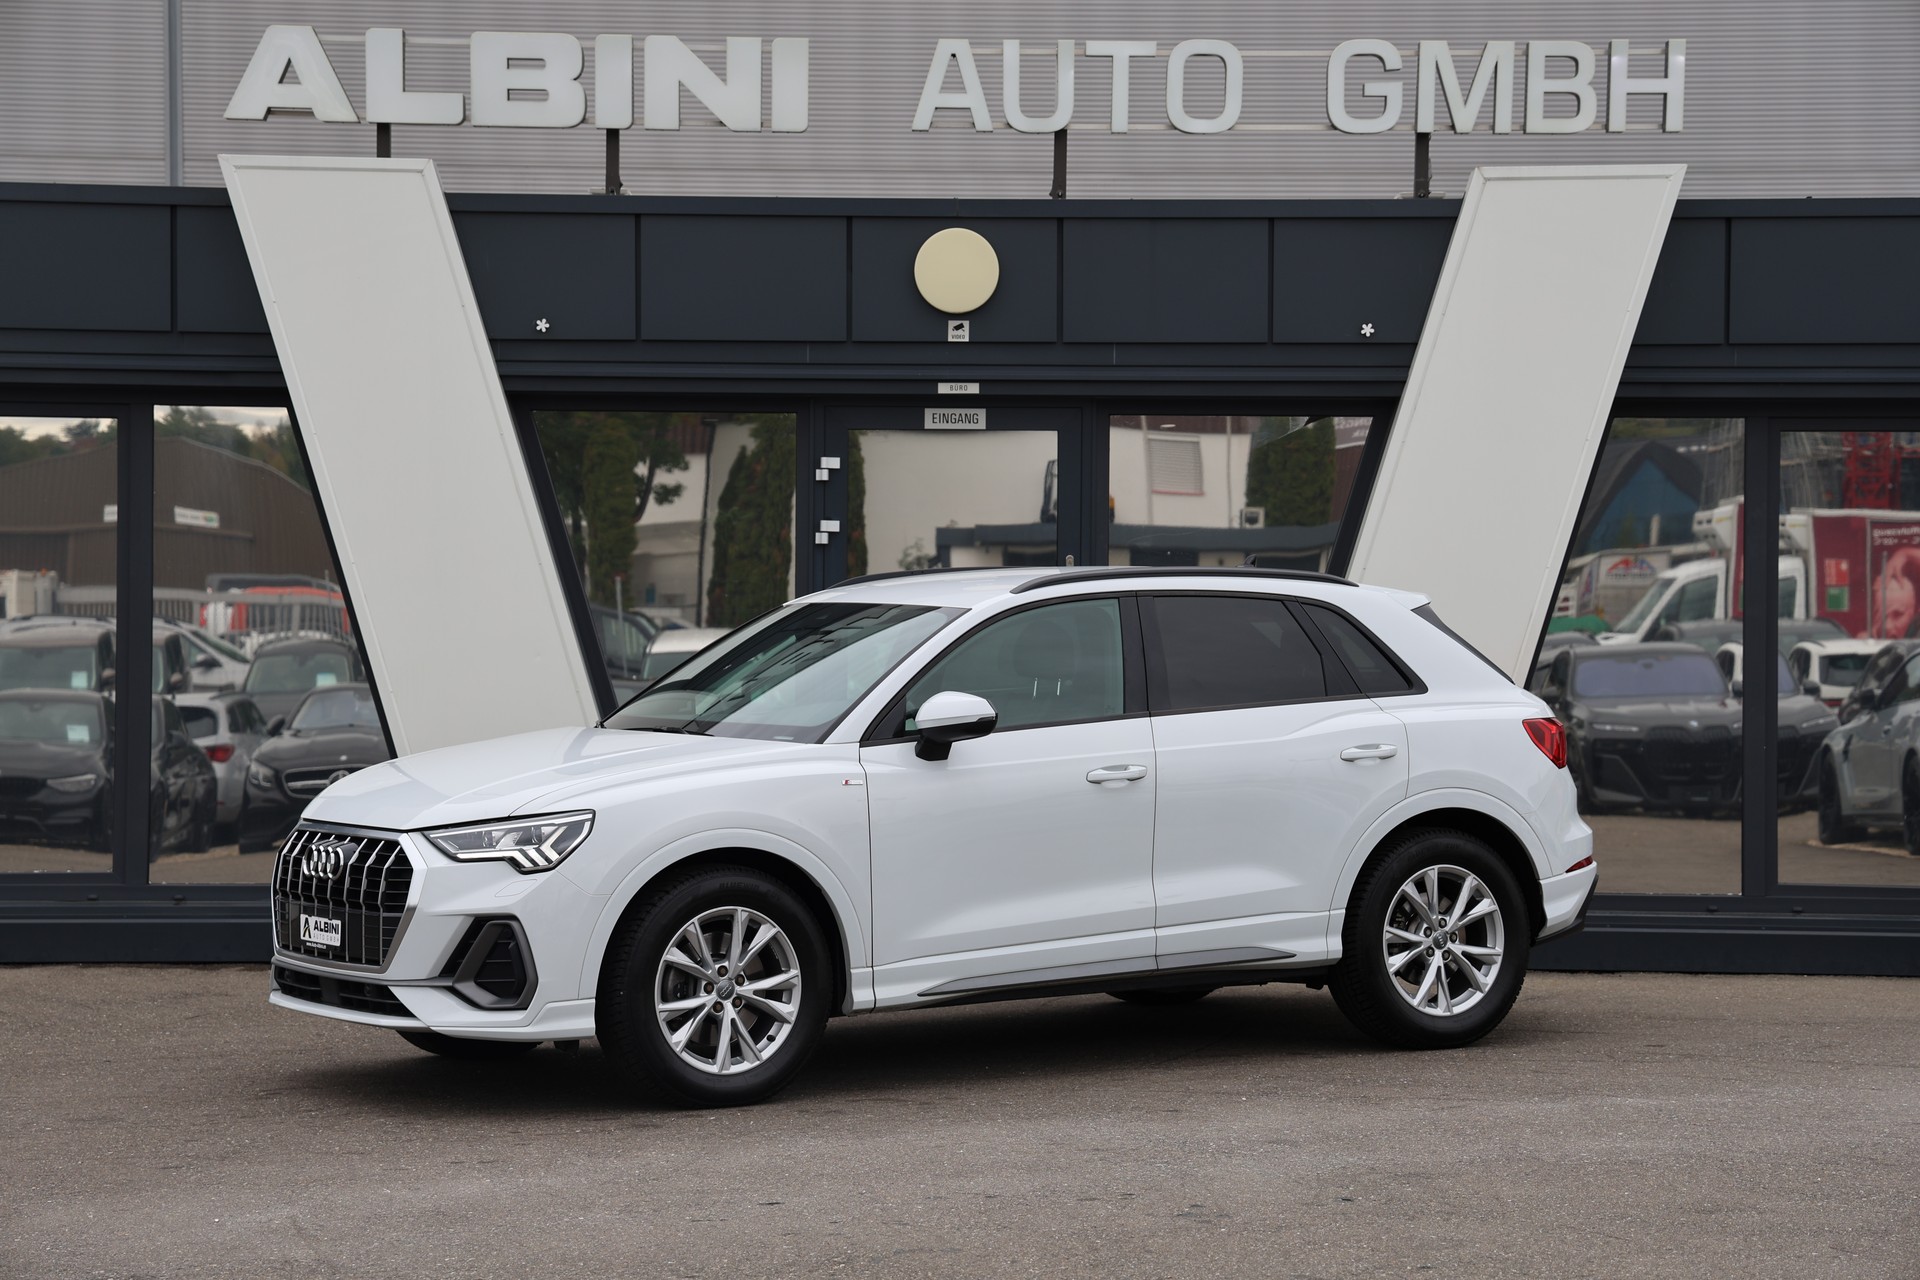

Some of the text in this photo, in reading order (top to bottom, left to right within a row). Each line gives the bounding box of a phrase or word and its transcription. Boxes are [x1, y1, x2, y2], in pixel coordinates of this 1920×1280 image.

[224, 25, 1688, 134] ALBINI AUTO GMBH
[932, 412, 979, 424] EINGANG
[313, 920, 339, 935] ALBINI
